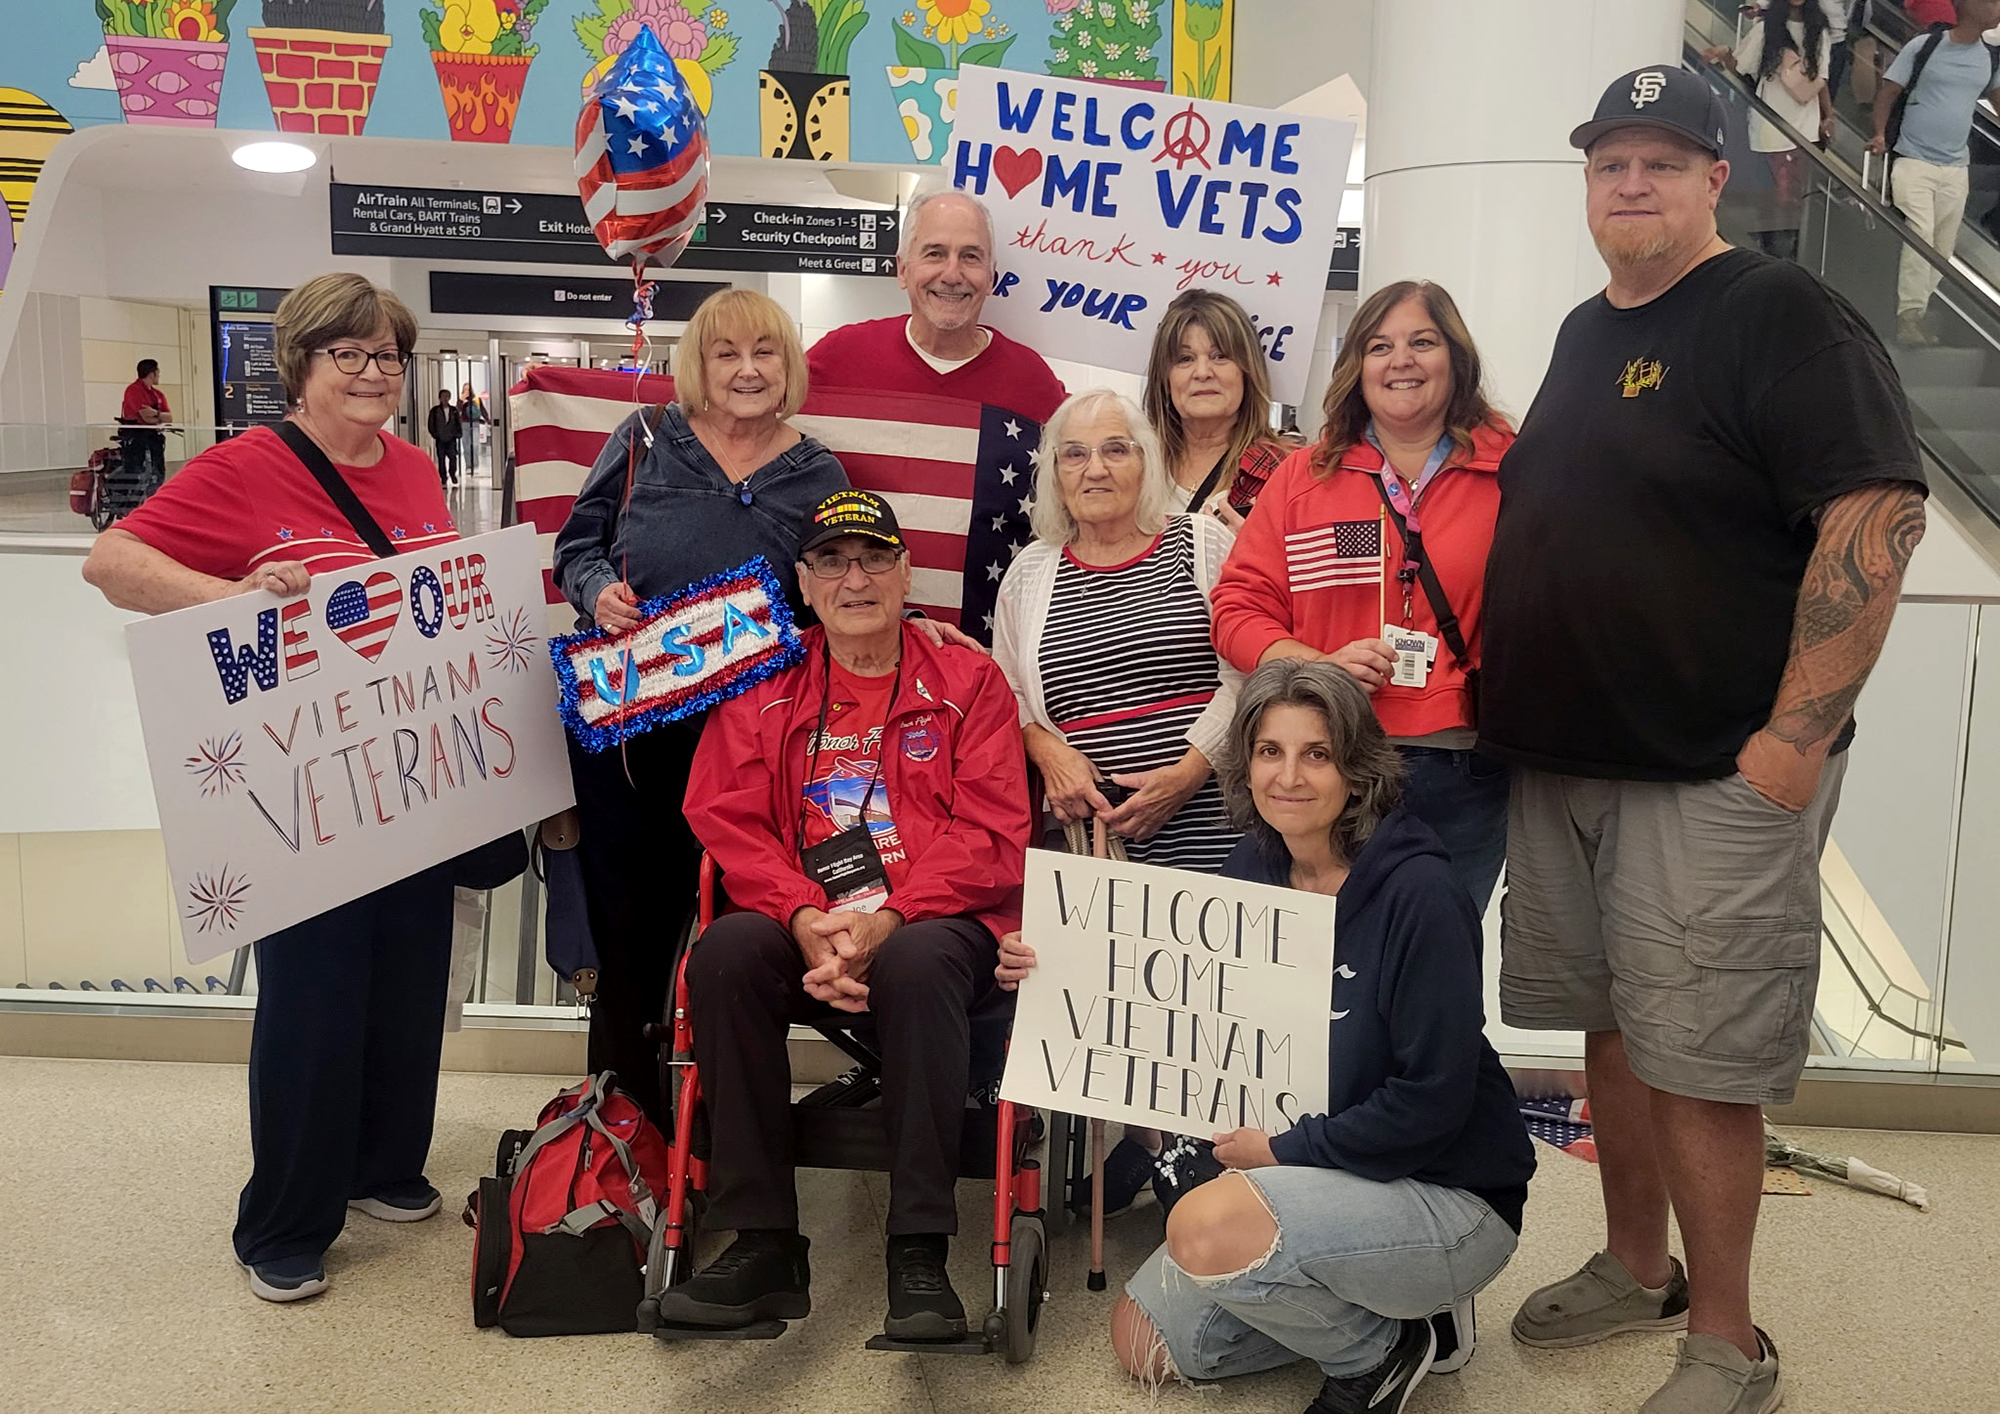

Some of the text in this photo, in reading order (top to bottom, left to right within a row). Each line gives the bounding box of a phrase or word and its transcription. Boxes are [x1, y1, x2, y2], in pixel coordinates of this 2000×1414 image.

[1630, 71, 1667, 110] SF
[353, 208, 481, 224] Rental Cars, BART Trains
[357, 192, 481, 212] AirTrain All Terminals,
[1156, 170, 1302, 244] VETS
[369, 222, 481, 237] & Grand Hyatt at SFO
[538, 220, 564, 233] Exit
[753, 211, 804, 226] Check-in
[806, 215, 836, 227] Zones
[741, 230, 858, 247] Security Checkpoint
[798, 257, 860, 270] Meet & Greet
[1008, 218, 1254, 290] thank you
[566, 292, 578, 300] Do
[579, 293, 592, 301] not
[1039, 278, 1148, 331] YOUR
[223, 336, 231, 348] 3
[224, 386, 234, 398] 2
[817, 491, 880, 509] VIETNAM
[823, 514, 875, 526] VETERAN
[206, 553, 495, 706] WE OUR
[588, 600, 771, 707] USA
[262, 651, 482, 757] VIETNAM
[247, 697, 517, 854] VETERANS
[1053, 870, 1299, 968] WELCOME
[1108, 938, 1249, 1019] HOME
[1062, 988, 1291, 1085] VIETNAM
[1041, 1039, 1298, 1137] VETERANS
